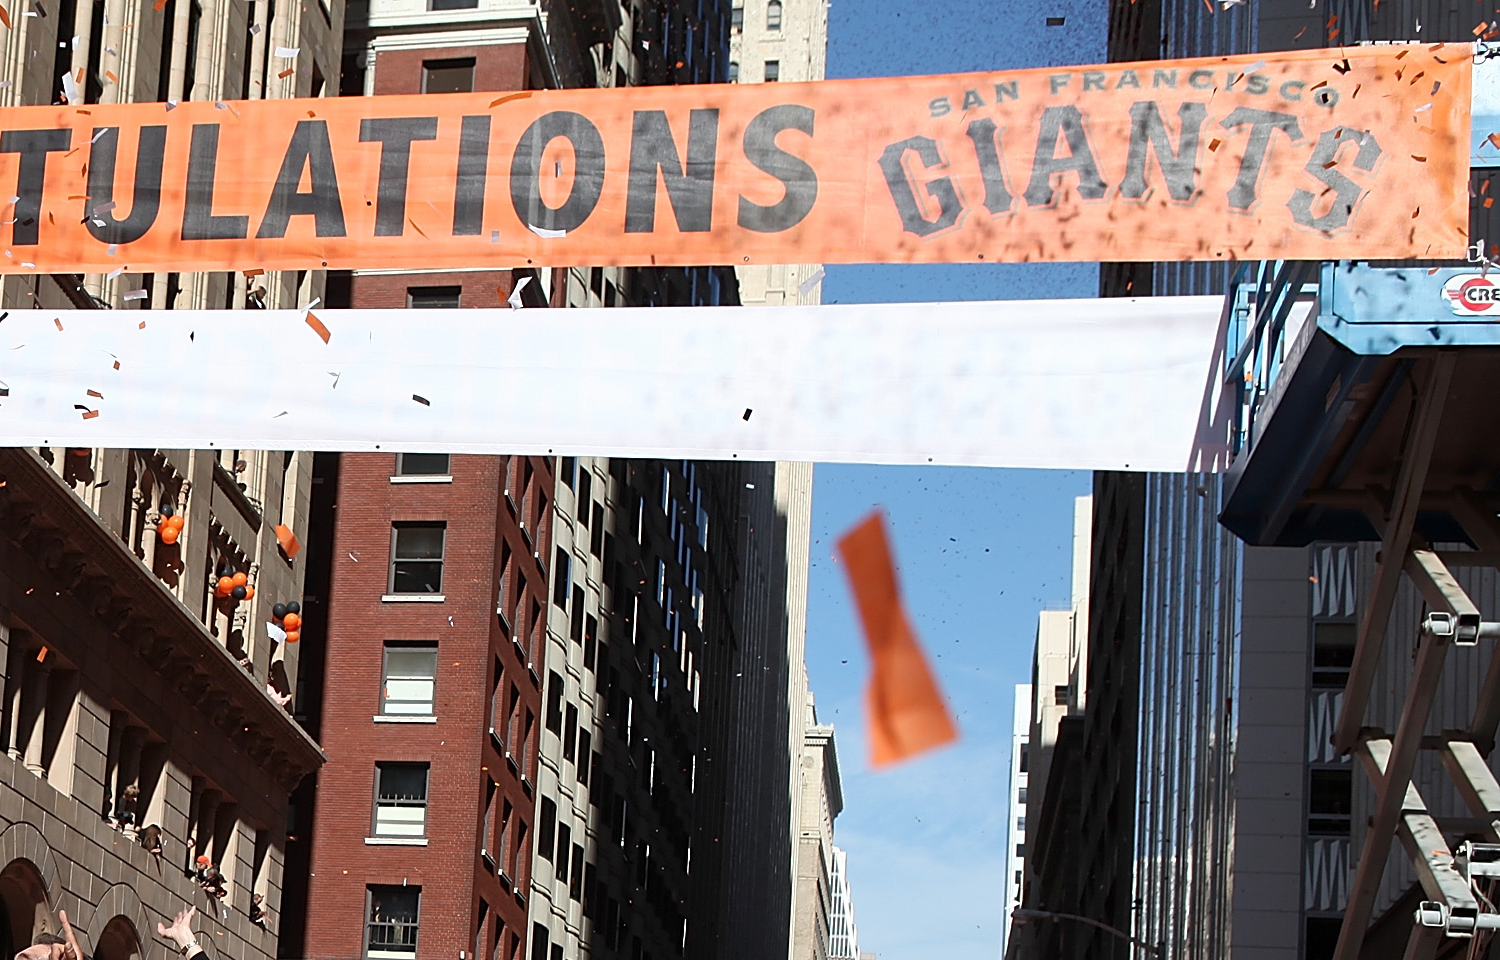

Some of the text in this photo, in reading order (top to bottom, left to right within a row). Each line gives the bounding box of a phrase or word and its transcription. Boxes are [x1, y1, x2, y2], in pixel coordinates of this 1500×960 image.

[928, 68, 1341, 118] SAN FRANCISCO
[877, 100, 1388, 239] GIANTS
